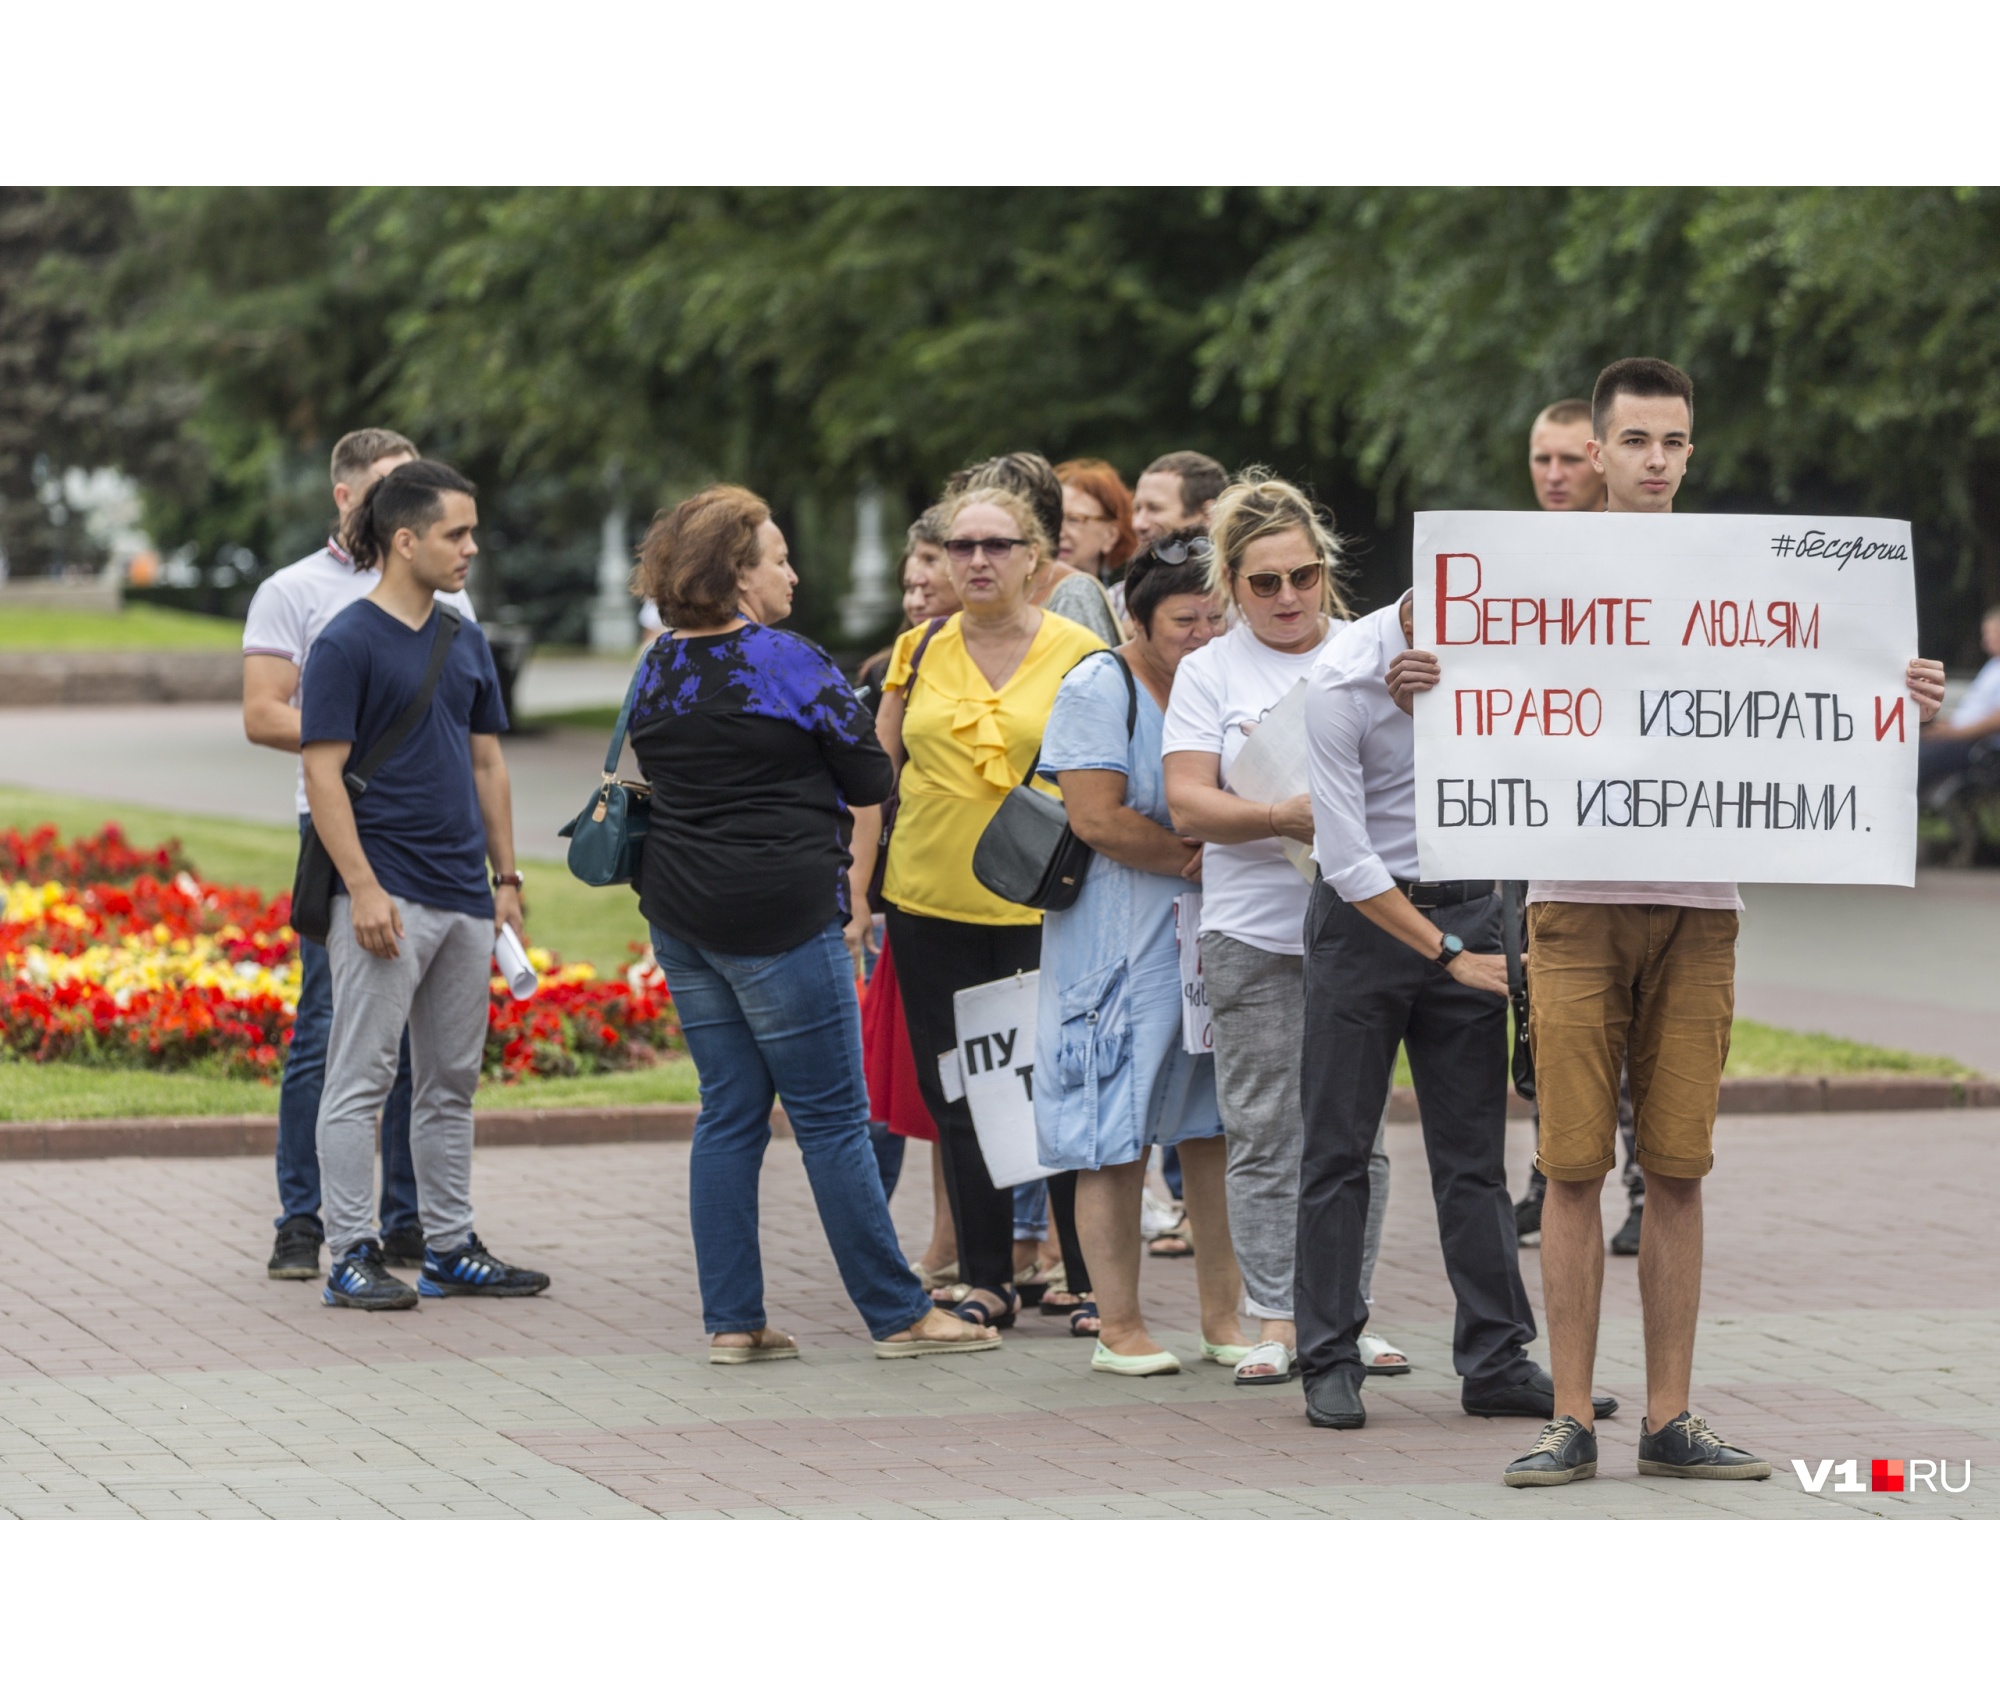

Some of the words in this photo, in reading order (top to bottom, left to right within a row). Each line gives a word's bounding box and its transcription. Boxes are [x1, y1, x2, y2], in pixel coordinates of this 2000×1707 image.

[1771, 530, 1908, 571] #бессрочка
[1435, 553, 1652, 646] ВЕРНИТЕ
[1682, 600, 1819, 649] ЛЮДЯМ
[1455, 687, 1602, 737] ПРАВО
[1640, 690, 1854, 742] ИЗБИРАТЬ
[1875, 695, 1905, 743] И
[1437, 779, 1548, 827] БЫТЬ
[1577, 780, 1871, 832] ИЗБРАННЫМИ.
